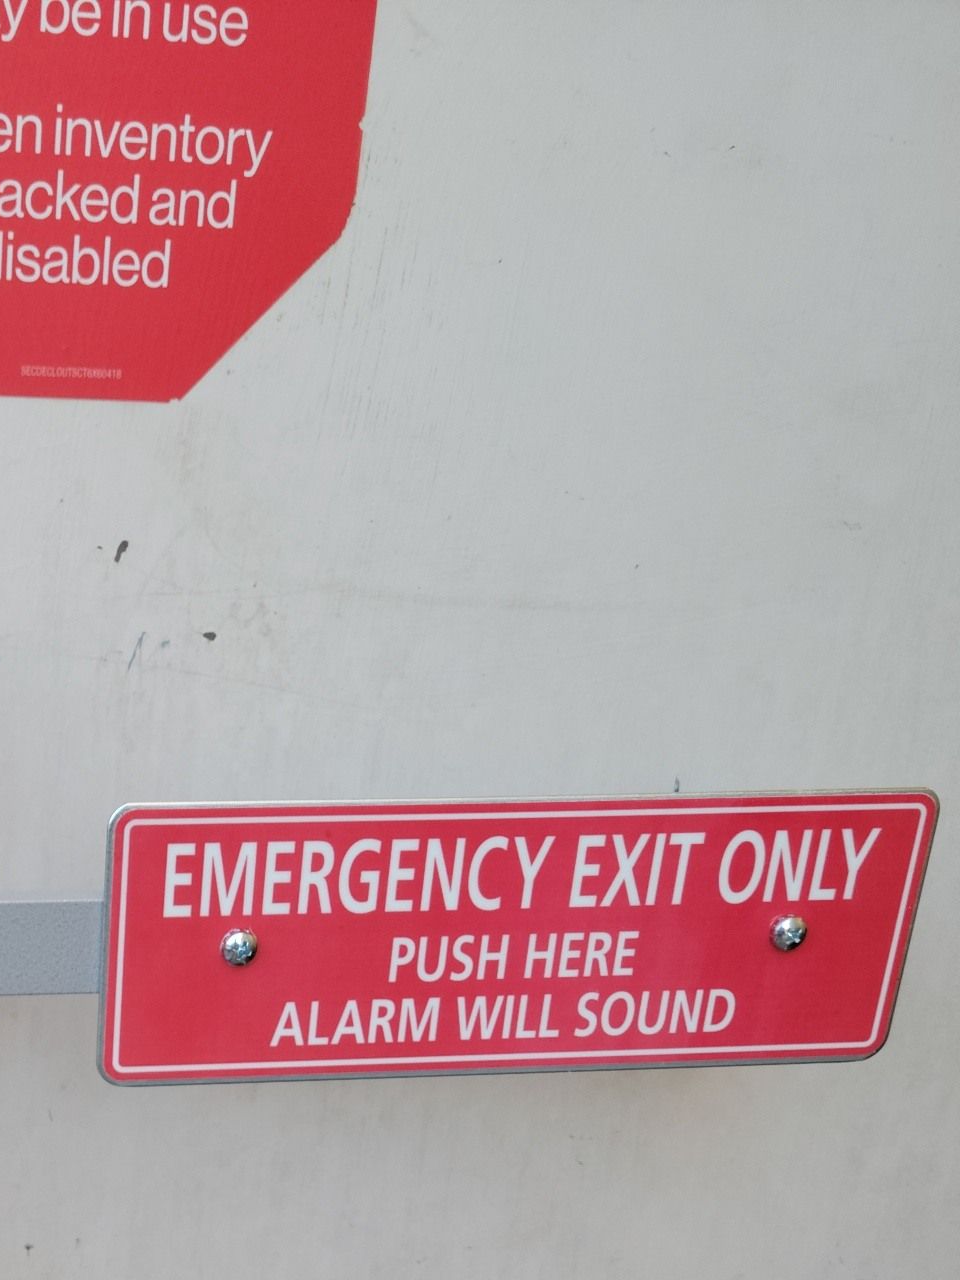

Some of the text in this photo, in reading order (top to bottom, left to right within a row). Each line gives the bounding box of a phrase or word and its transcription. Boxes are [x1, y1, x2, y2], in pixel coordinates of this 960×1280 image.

[40, 0, 101, 37] be
[113, 0, 150, 40] in
[163, 2, 248, 47] use
[54, 103, 273, 178] inventory
[148, 179, 237, 229] and
[162, 827, 882, 918] EMERGENCY EXIT ONLY
[388, 930, 640, 983] PUSH HERE
[269, 988, 736, 1047] ALARM WILL SOUND
